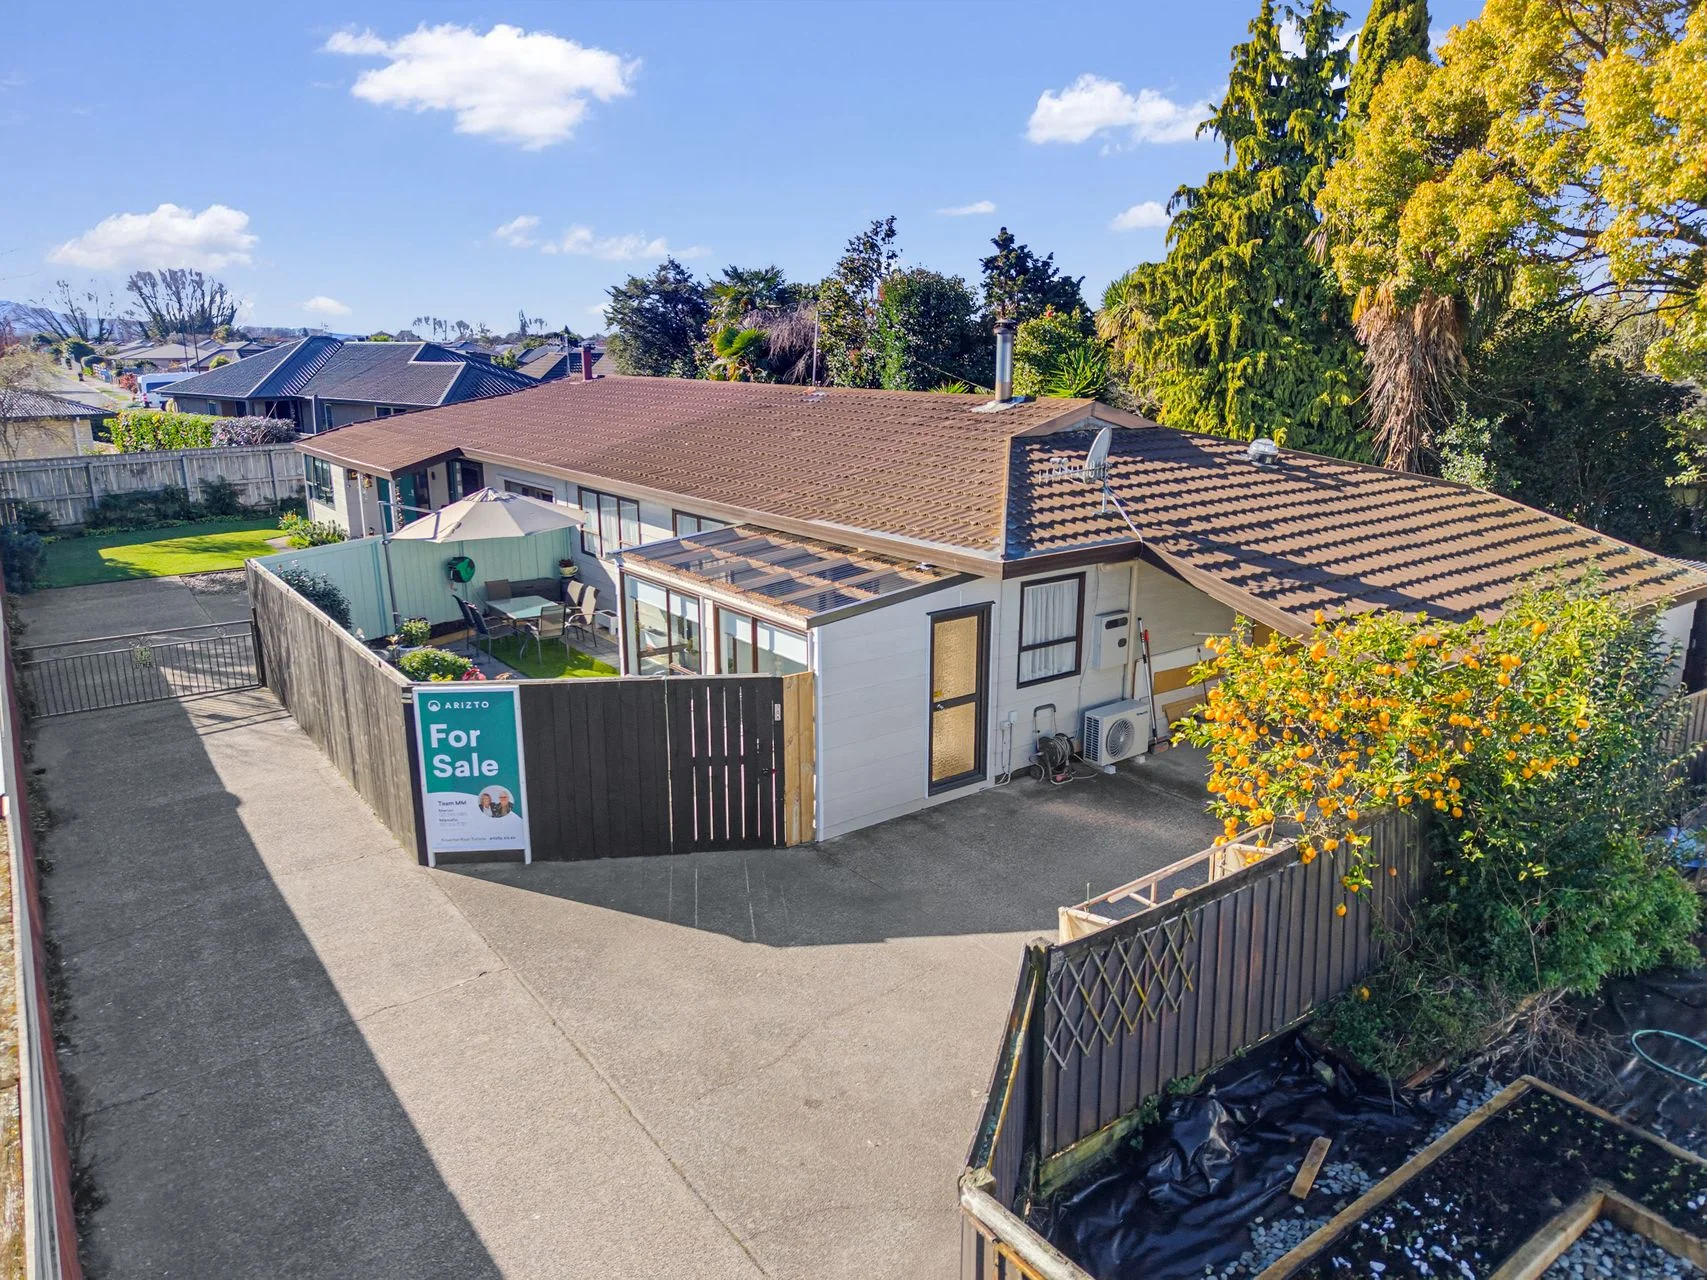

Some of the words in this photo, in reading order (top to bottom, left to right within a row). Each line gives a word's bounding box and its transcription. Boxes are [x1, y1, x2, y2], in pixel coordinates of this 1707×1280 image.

[445, 701, 489, 709] ARIZTO
[429, 723, 480, 748] For
[432, 752, 499, 778] Sale
